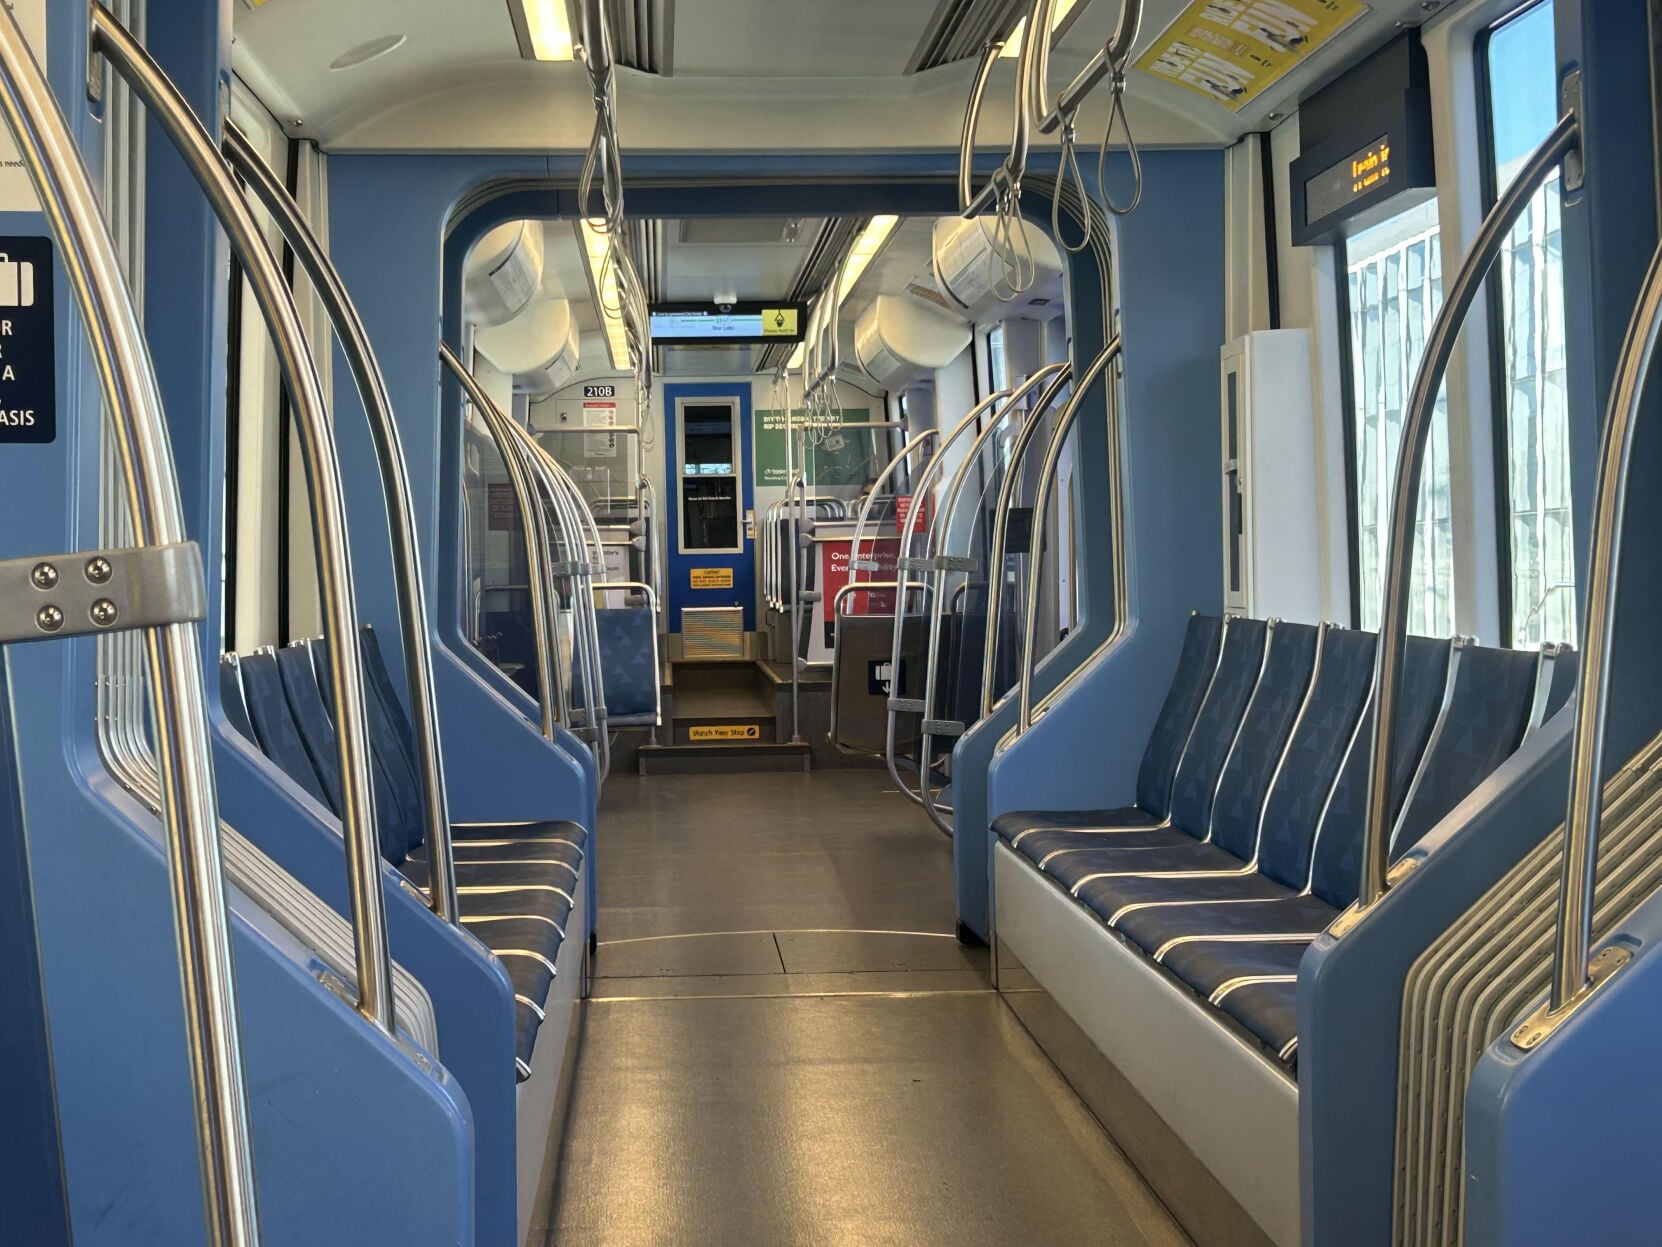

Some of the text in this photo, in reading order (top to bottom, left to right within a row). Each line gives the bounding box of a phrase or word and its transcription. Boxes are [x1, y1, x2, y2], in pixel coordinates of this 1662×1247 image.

[2, 364, 15, 381] A
[587, 386, 612, 397] 210B
[831, 552, 850, 560] One
